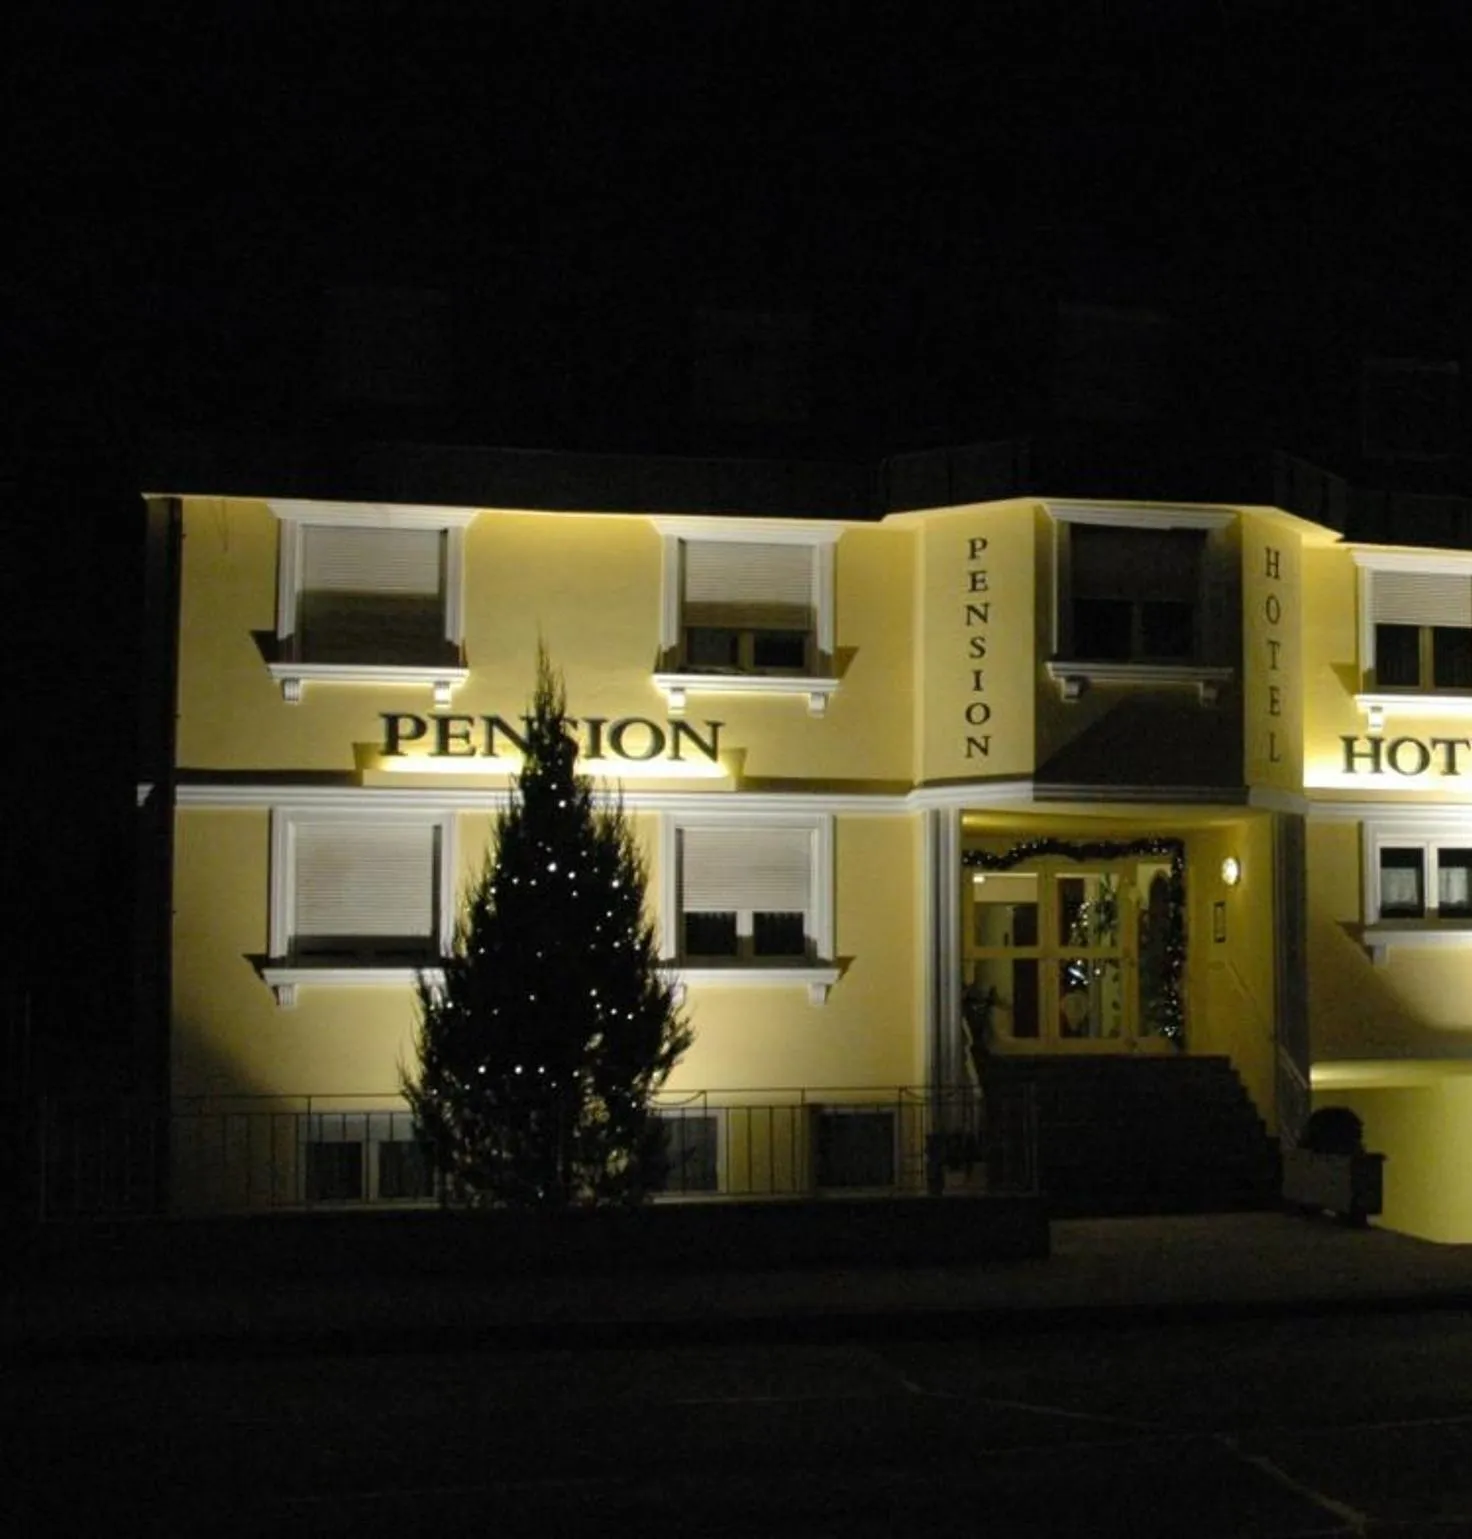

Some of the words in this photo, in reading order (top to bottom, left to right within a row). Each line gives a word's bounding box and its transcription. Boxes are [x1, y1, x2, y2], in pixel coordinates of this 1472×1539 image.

[378, 711, 726, 764] PENION
[965, 536, 992, 759] PENSION
[1265, 546, 1281, 763] HOTEL
